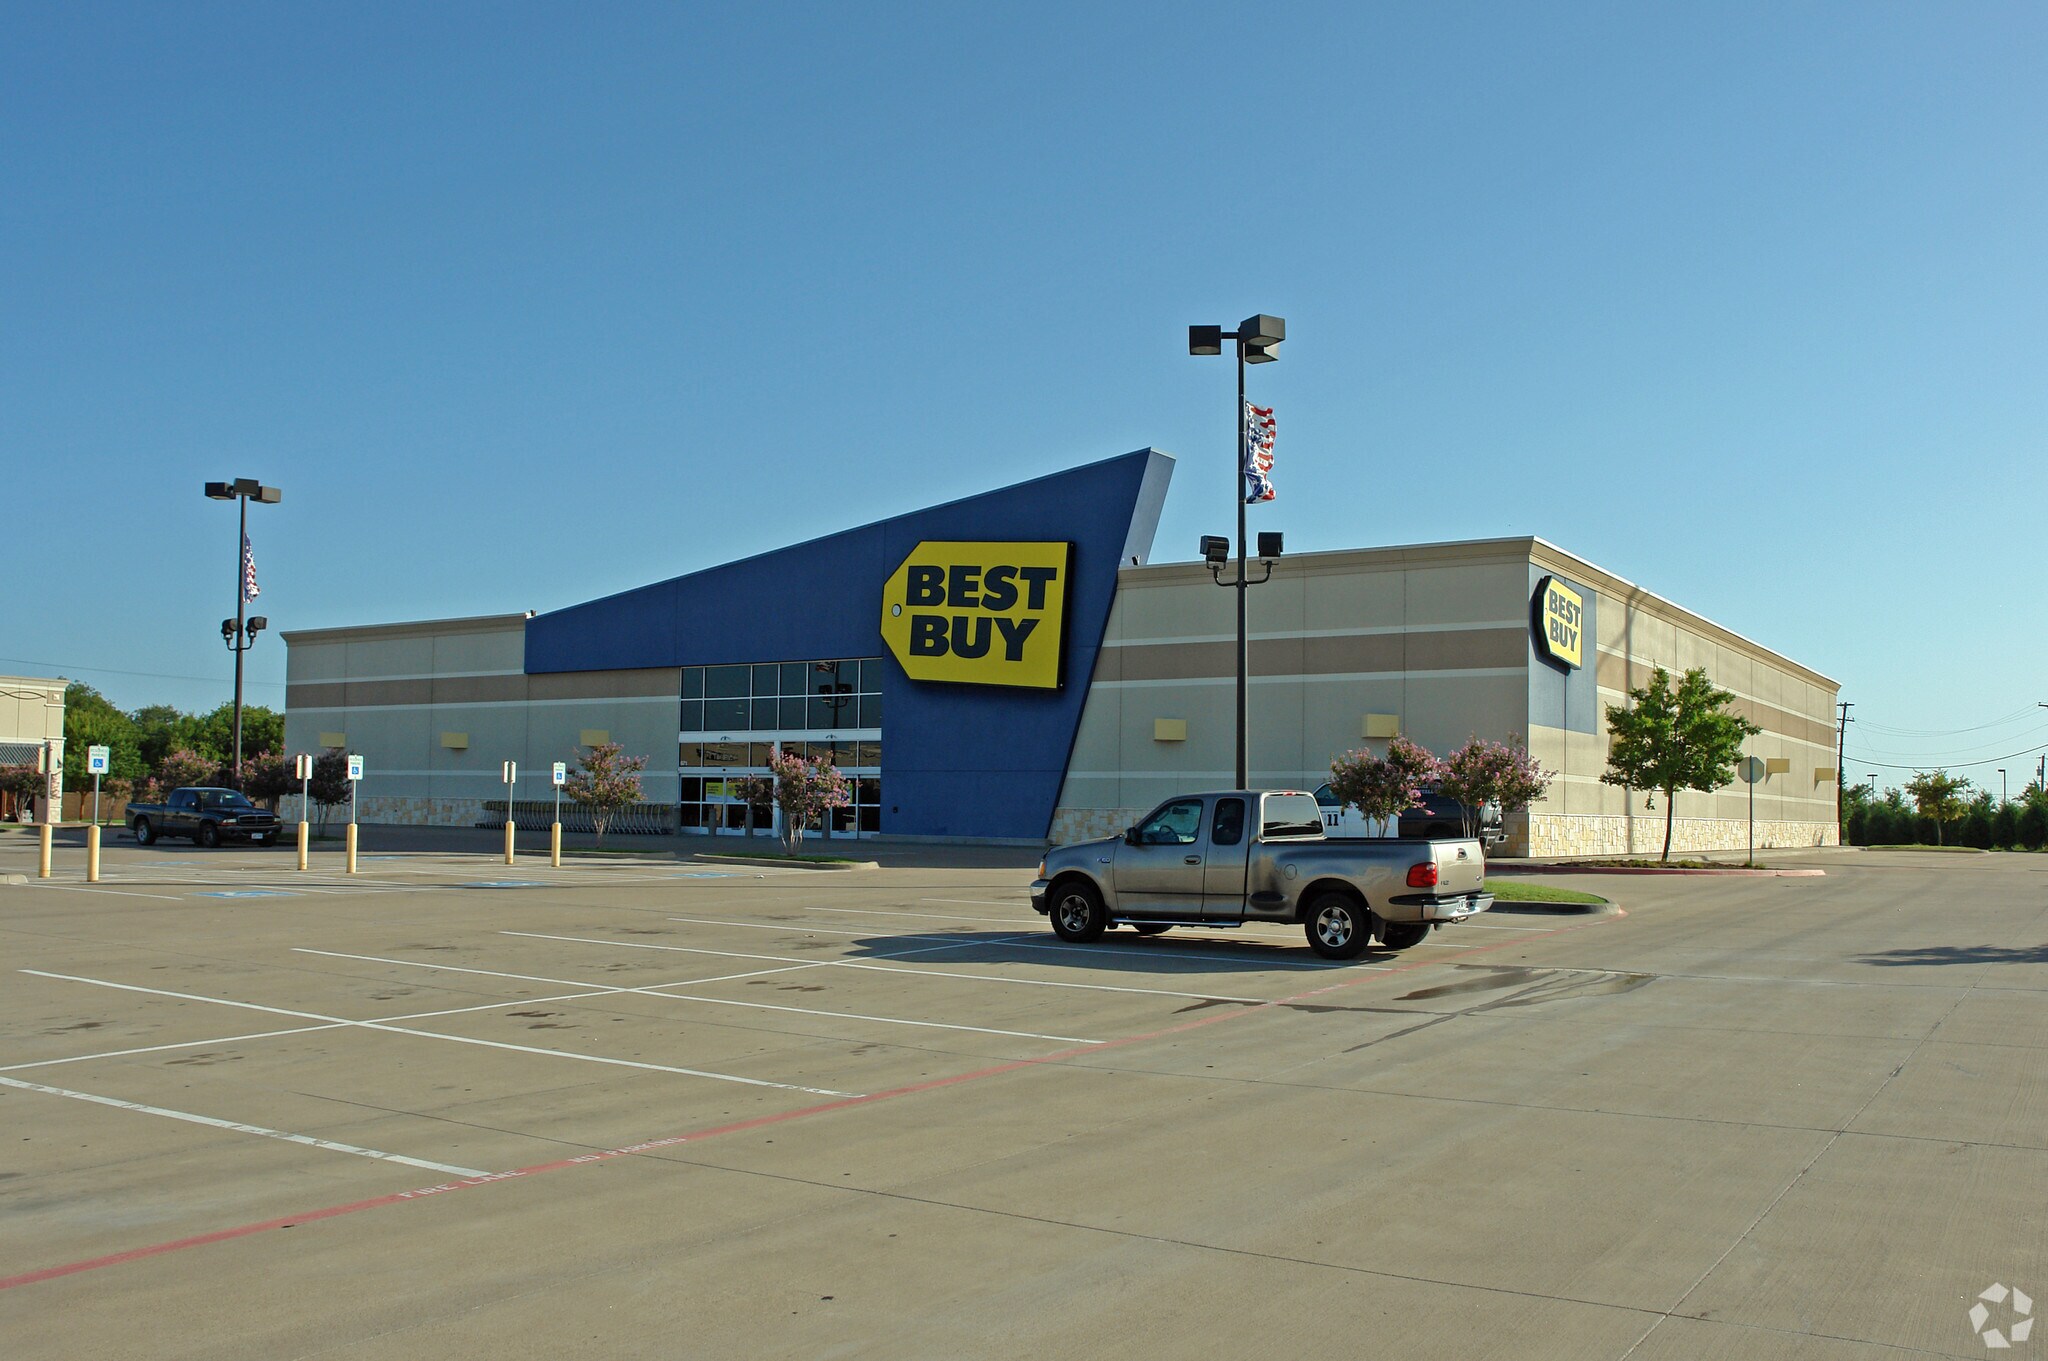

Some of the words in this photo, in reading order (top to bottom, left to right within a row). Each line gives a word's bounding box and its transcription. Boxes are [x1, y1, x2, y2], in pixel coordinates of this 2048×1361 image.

[906, 565, 1057, 611] BEST
[1549, 588, 1580, 628] BEST
[909, 614, 1041, 661] BUY
[1549, 616, 1578, 652] BUY
[1327, 813, 1339, 826] 11
